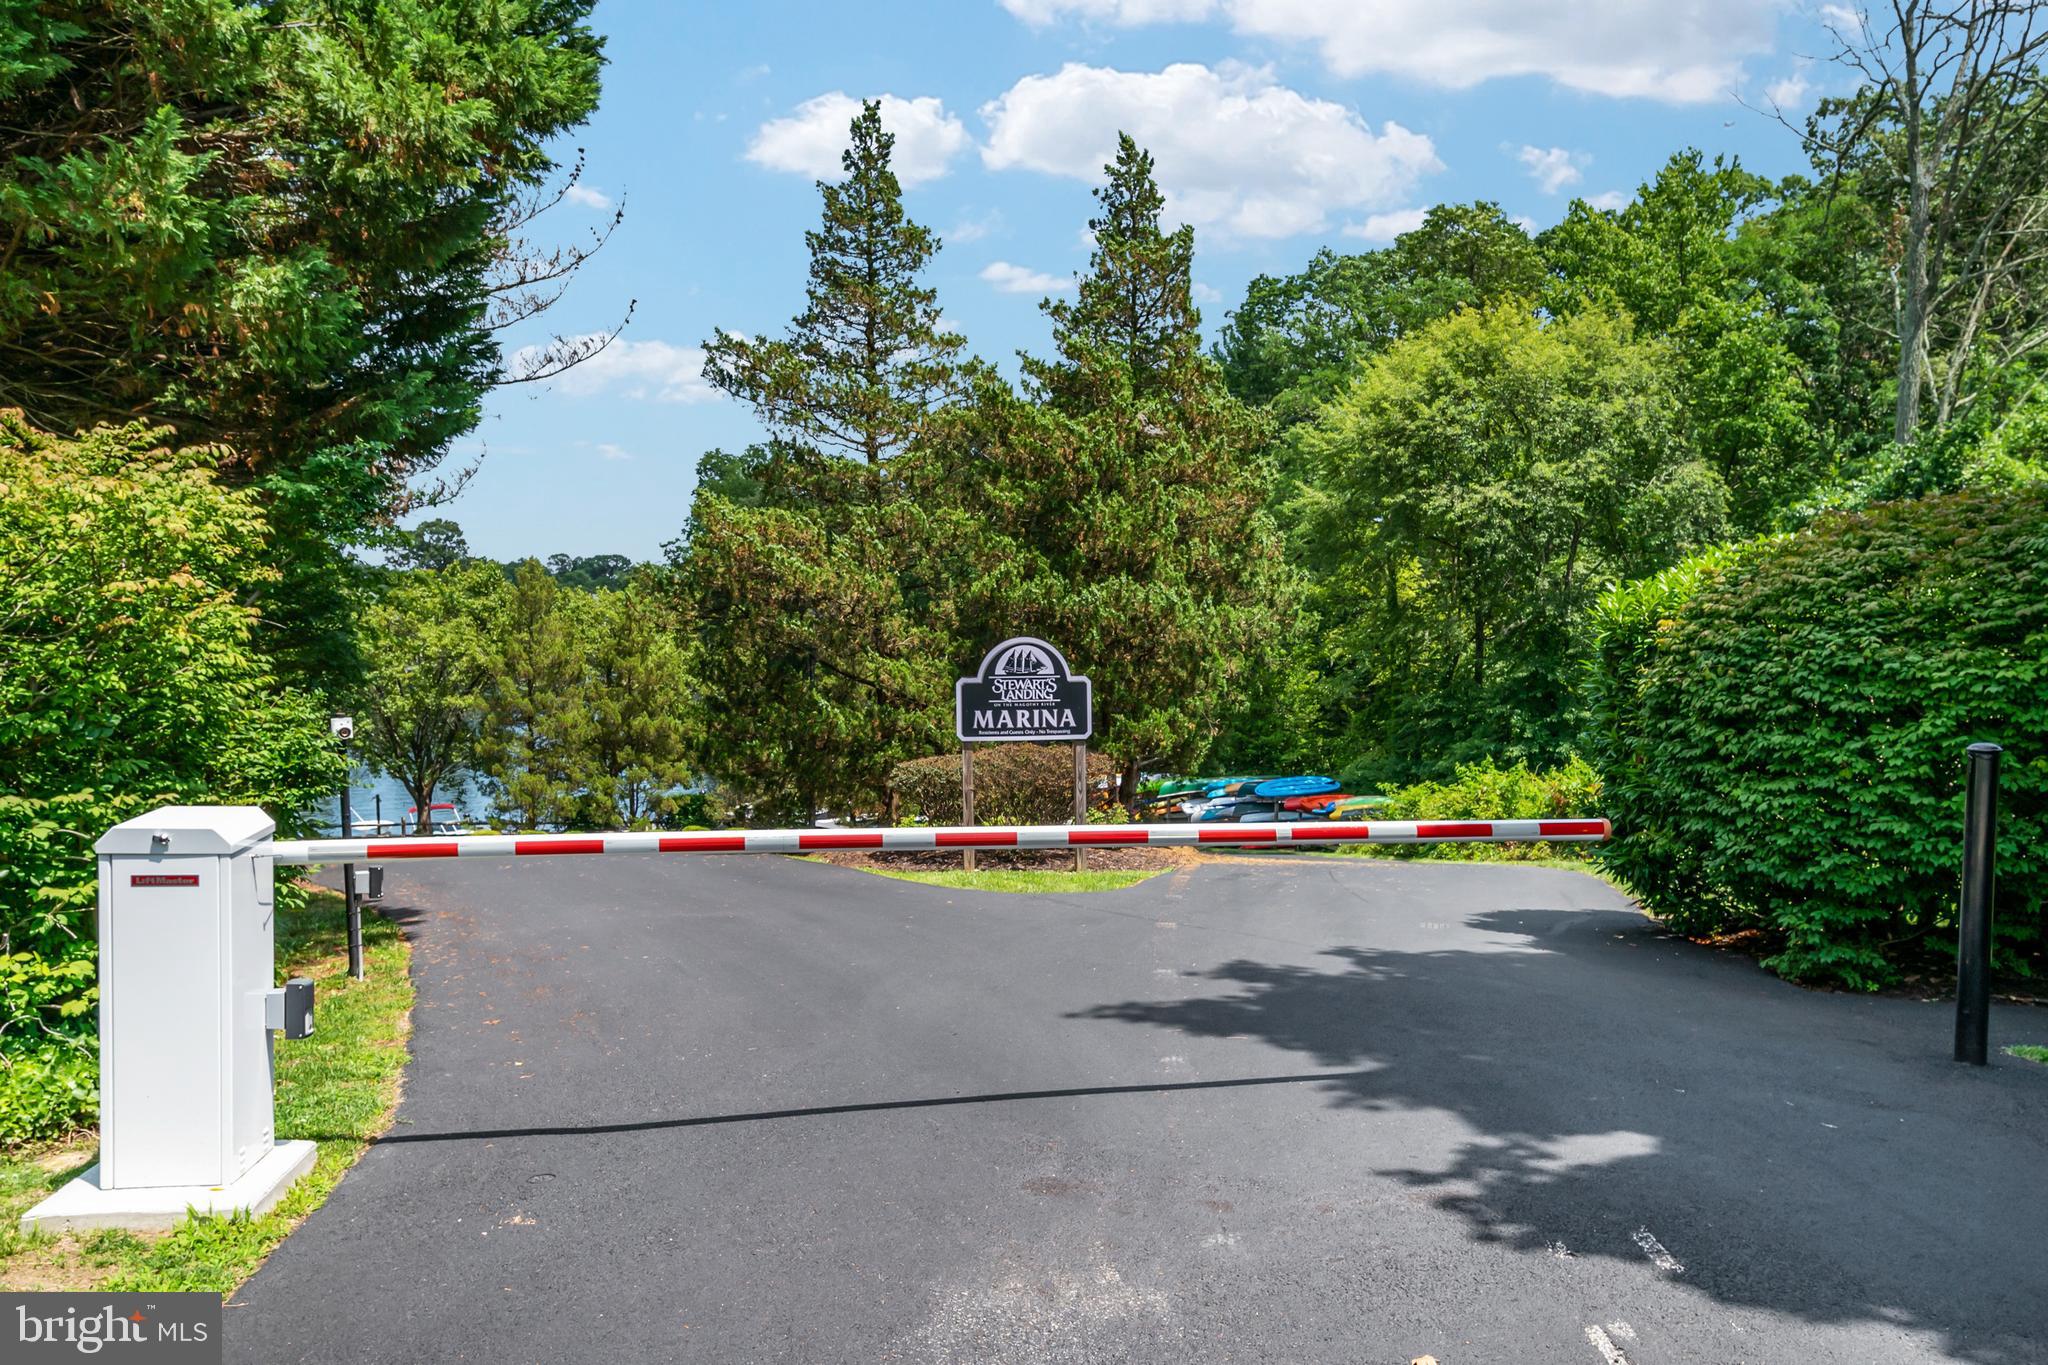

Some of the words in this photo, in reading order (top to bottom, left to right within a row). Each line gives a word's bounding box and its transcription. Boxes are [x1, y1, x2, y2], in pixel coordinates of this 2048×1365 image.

[992, 678, 1057, 693] STEWART'S
[1001, 689, 1053, 702] LANDING
[973, 708, 1077, 729] MARINA
[136, 876, 194, 884] LiftMaster
